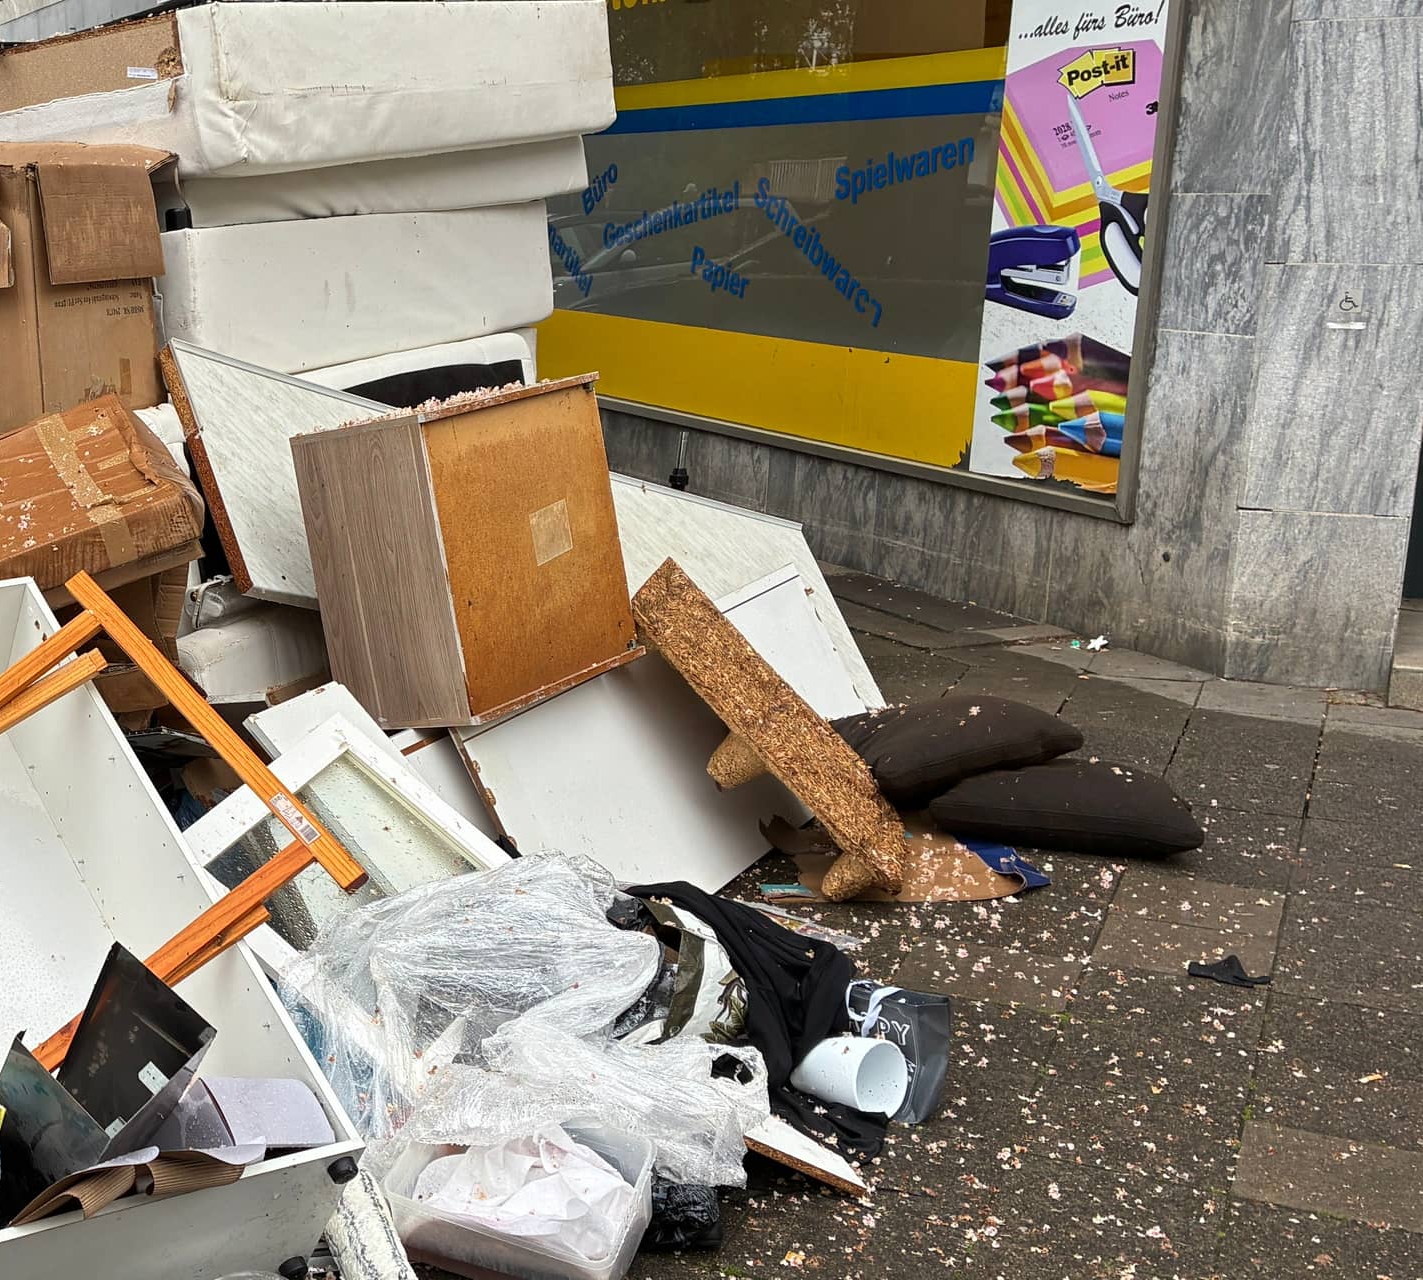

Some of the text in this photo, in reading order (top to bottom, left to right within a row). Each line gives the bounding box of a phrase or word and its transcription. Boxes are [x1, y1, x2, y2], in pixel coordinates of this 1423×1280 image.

[1073, 12, 1106, 40] fürs
[1114, 0, 1165, 28] Büro!
[1067, 54, 1130, 86] Post-it
[1108, 90, 1129, 102] Notes
[581, 163, 618, 215] Büro
[835, 136, 975, 204] Spielwaren
[602, 180, 740, 250] Geschenkartikel
[690, 246, 750, 299] Papier
